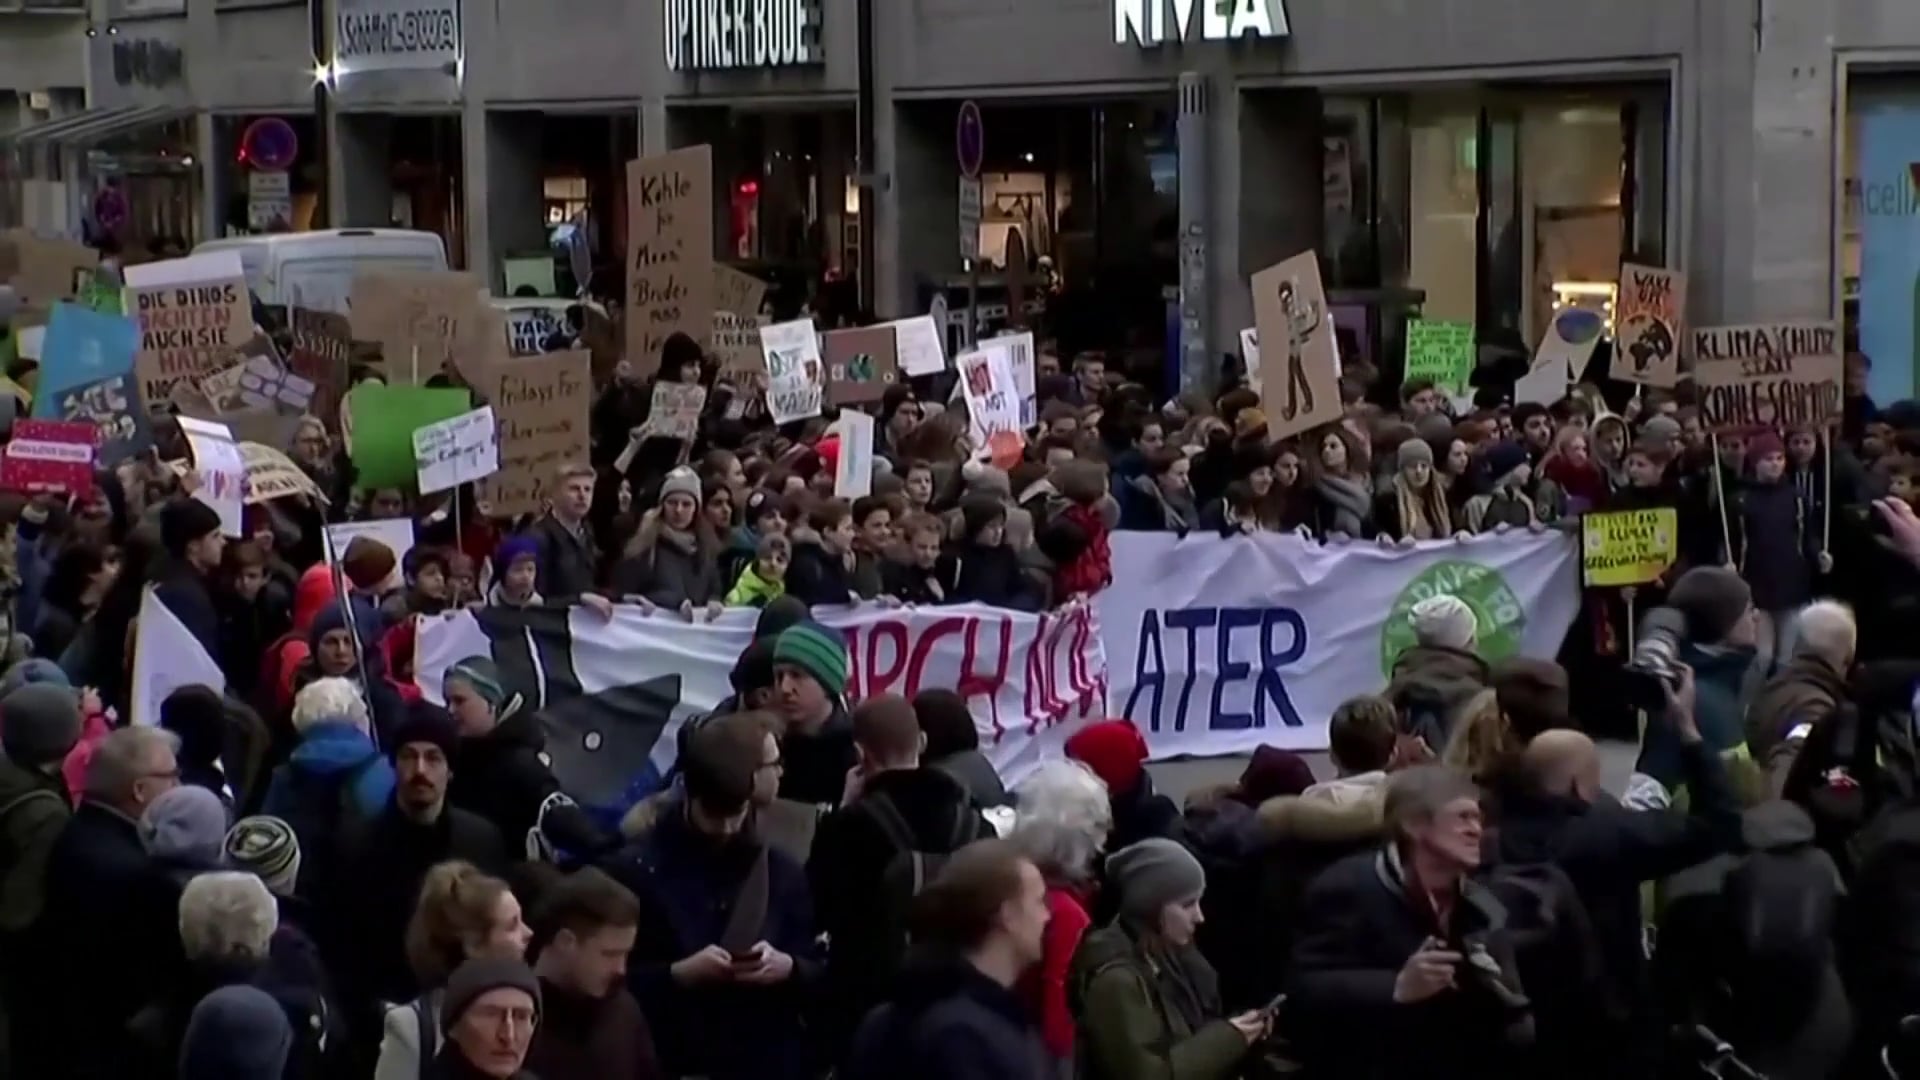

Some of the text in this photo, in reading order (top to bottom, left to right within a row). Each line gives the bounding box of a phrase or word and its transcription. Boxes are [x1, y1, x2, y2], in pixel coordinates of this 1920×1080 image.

[387, 9, 455, 52] LOWA
[1114, 0, 1279, 48] NIVEA
[137, 283, 238, 310] DIE DINOS
[143, 327, 228, 351] AUCH SIE
[1122, 606, 1307, 732] ATER
